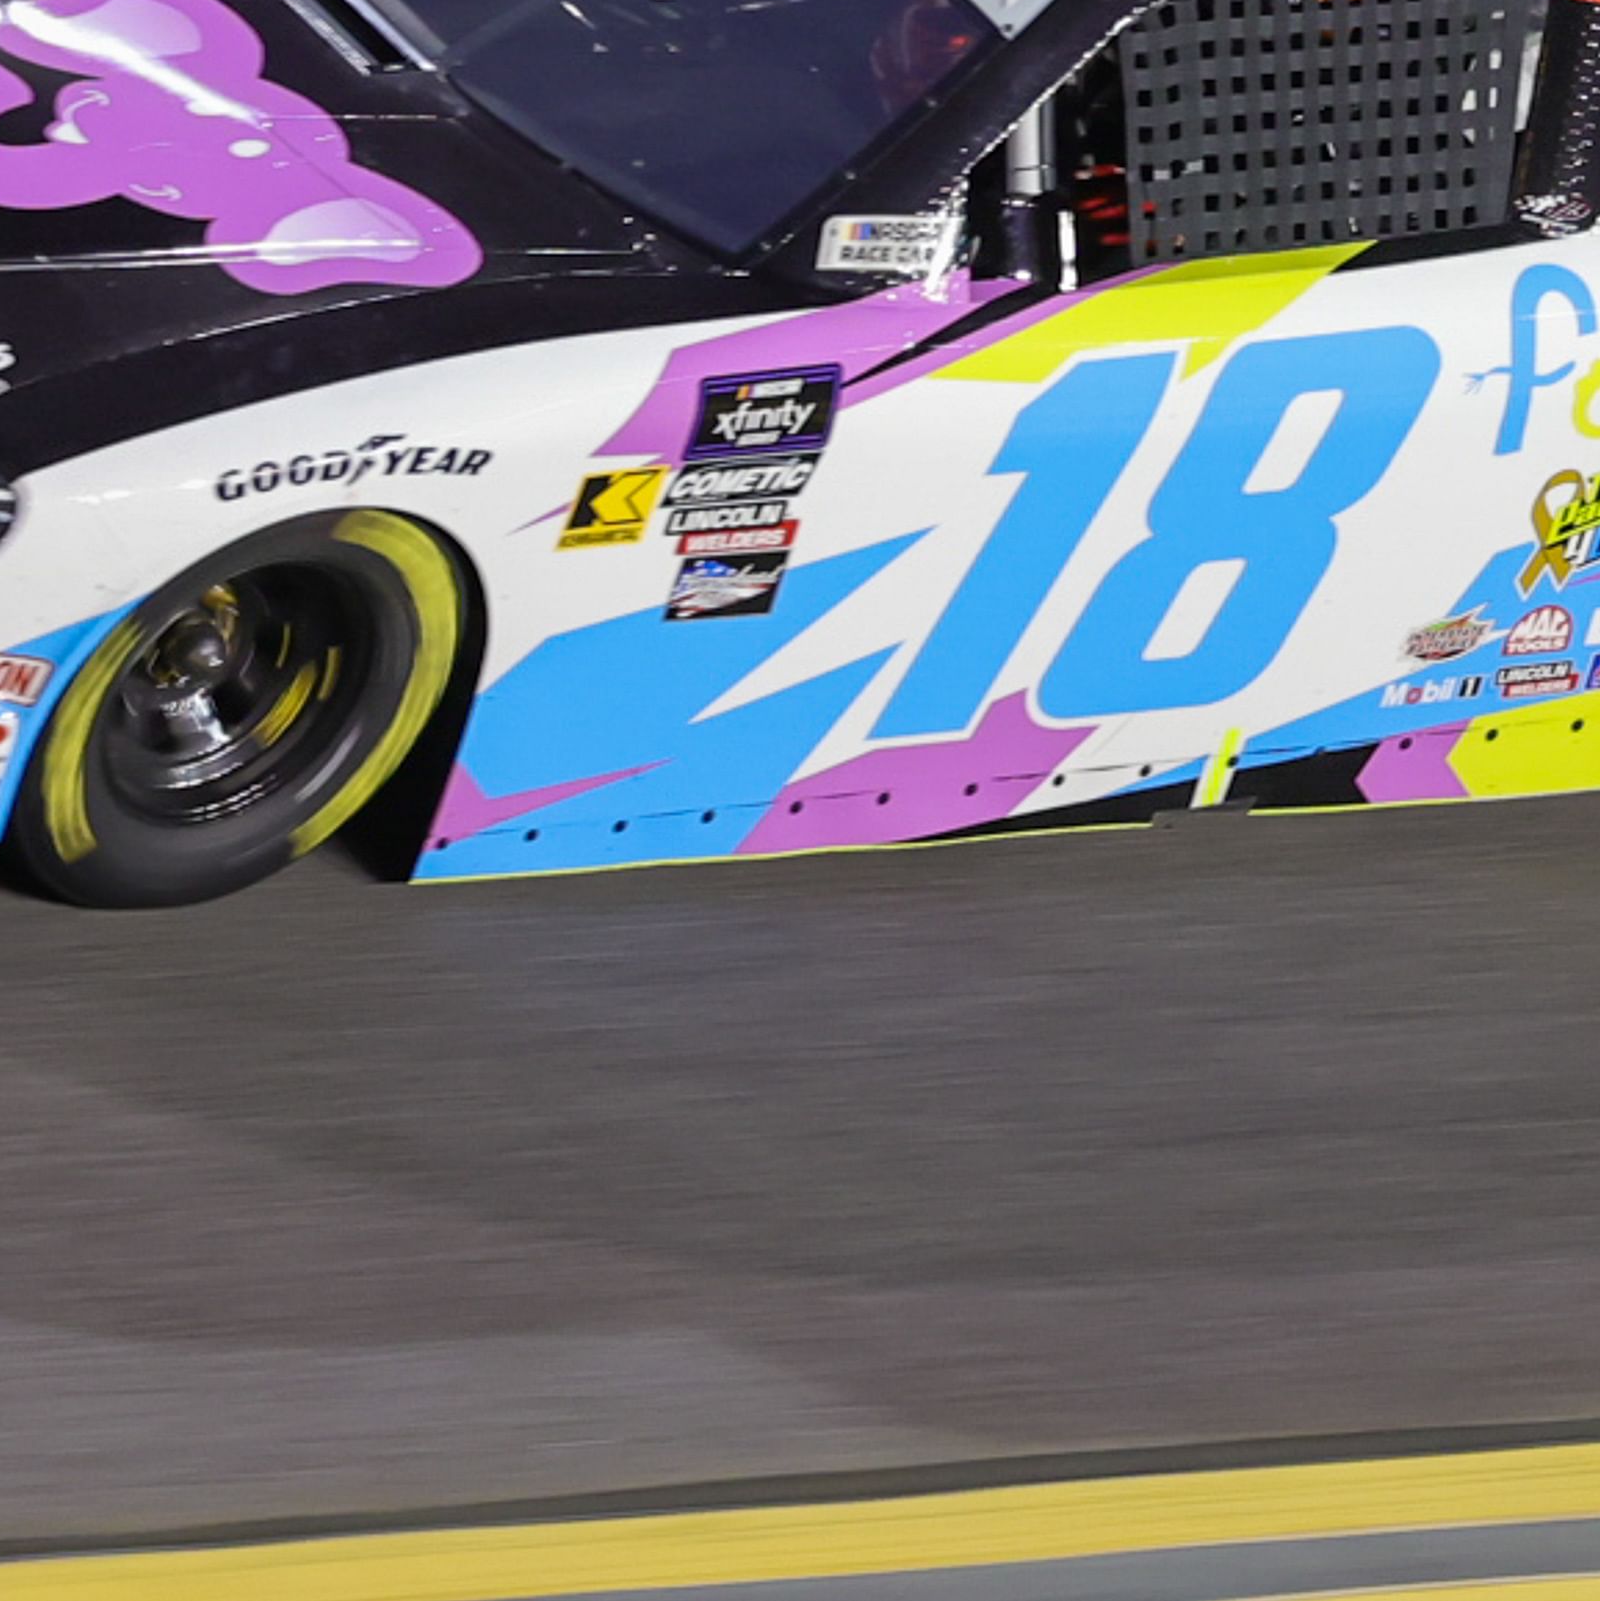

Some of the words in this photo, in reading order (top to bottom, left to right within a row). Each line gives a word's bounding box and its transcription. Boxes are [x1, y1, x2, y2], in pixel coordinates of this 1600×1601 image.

[839, 245, 891, 262] RACE
[712, 399, 817, 442] xfinity
[214, 433, 494, 503] GOODYEAR
[667, 462, 816, 500] COMETIC
[668, 503, 785, 532] LINCOLN
[863, 323, 1444, 742] 18
[685, 528, 790, 552] WELDERS
[1510, 607, 1570, 642] MAC
[1498, 662, 1570, 684] LINCOLN
[1380, 676, 1456, 708] Mobil
